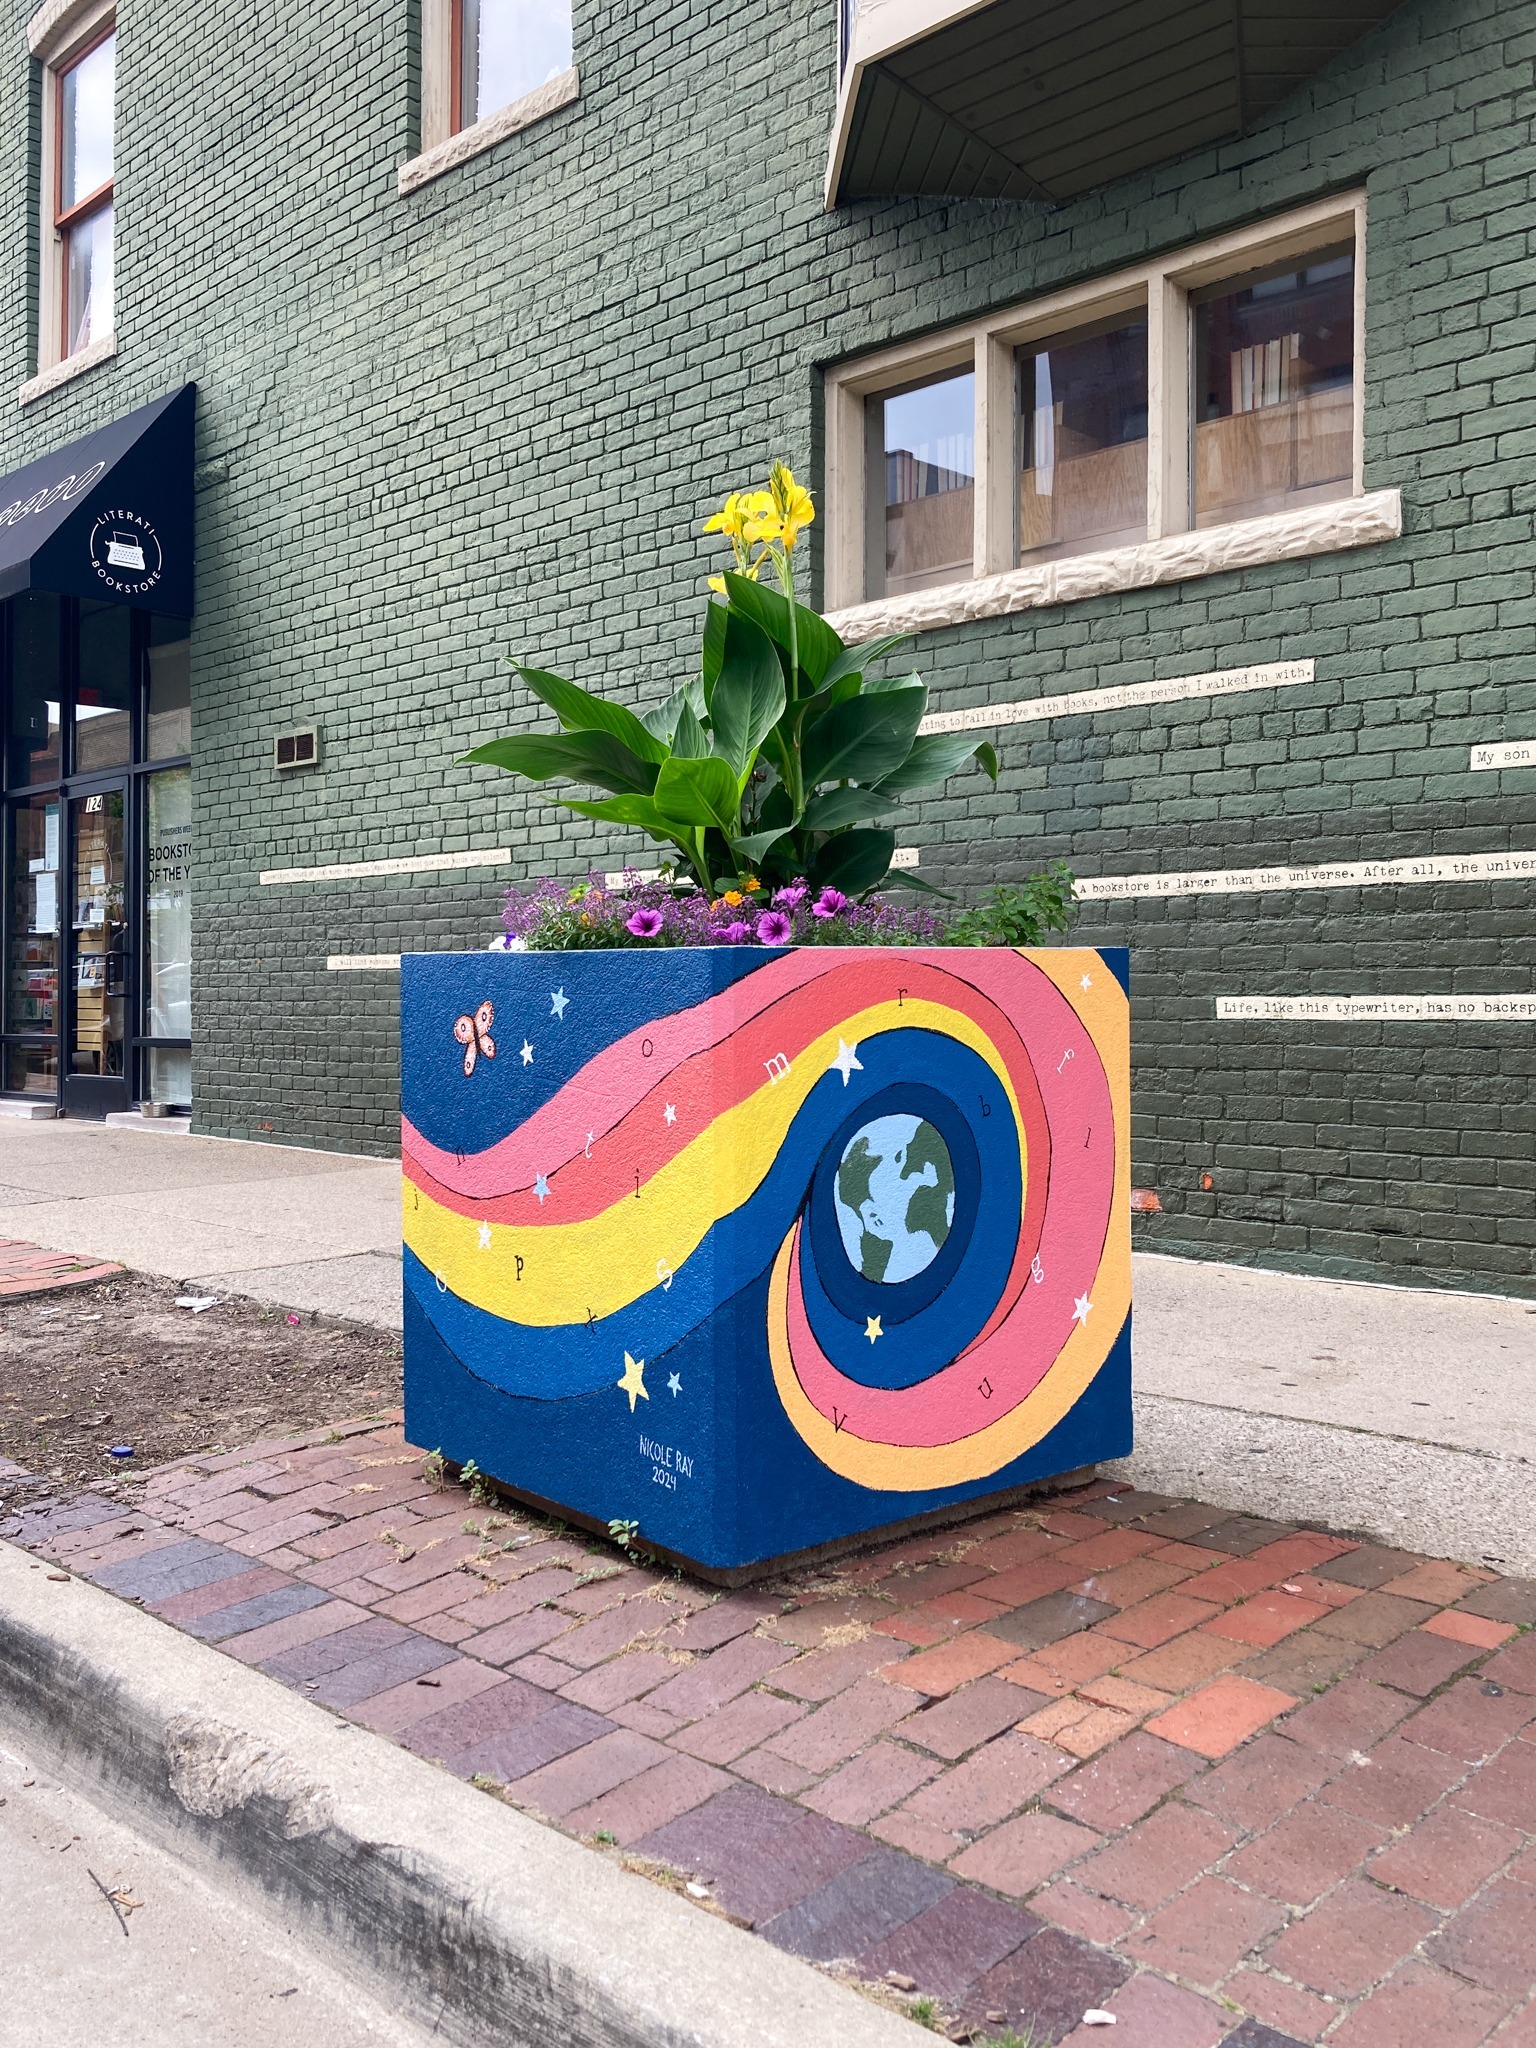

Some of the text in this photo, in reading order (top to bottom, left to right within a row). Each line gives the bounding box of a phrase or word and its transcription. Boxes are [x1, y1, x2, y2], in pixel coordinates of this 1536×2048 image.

[97, 510, 155, 534] LITERATI
[92, 560, 161, 594] BOOKSTORE
[919, 667, 1312, 731] cting to fall in love with books, not the person I walked in with.
[1477, 750, 1530, 765] My son
[88, 797, 102, 811] 124
[163, 866, 181, 881] THE
[1079, 857, 1536, 894] A bookstore is larger than the universe. After all, the univer
[1224, 1002, 1536, 1015] Life, like this typewriter, has no backsp
[640, 1434, 694, 1479] NICOLE RAY
[652, 1465, 677, 1492] 2024
